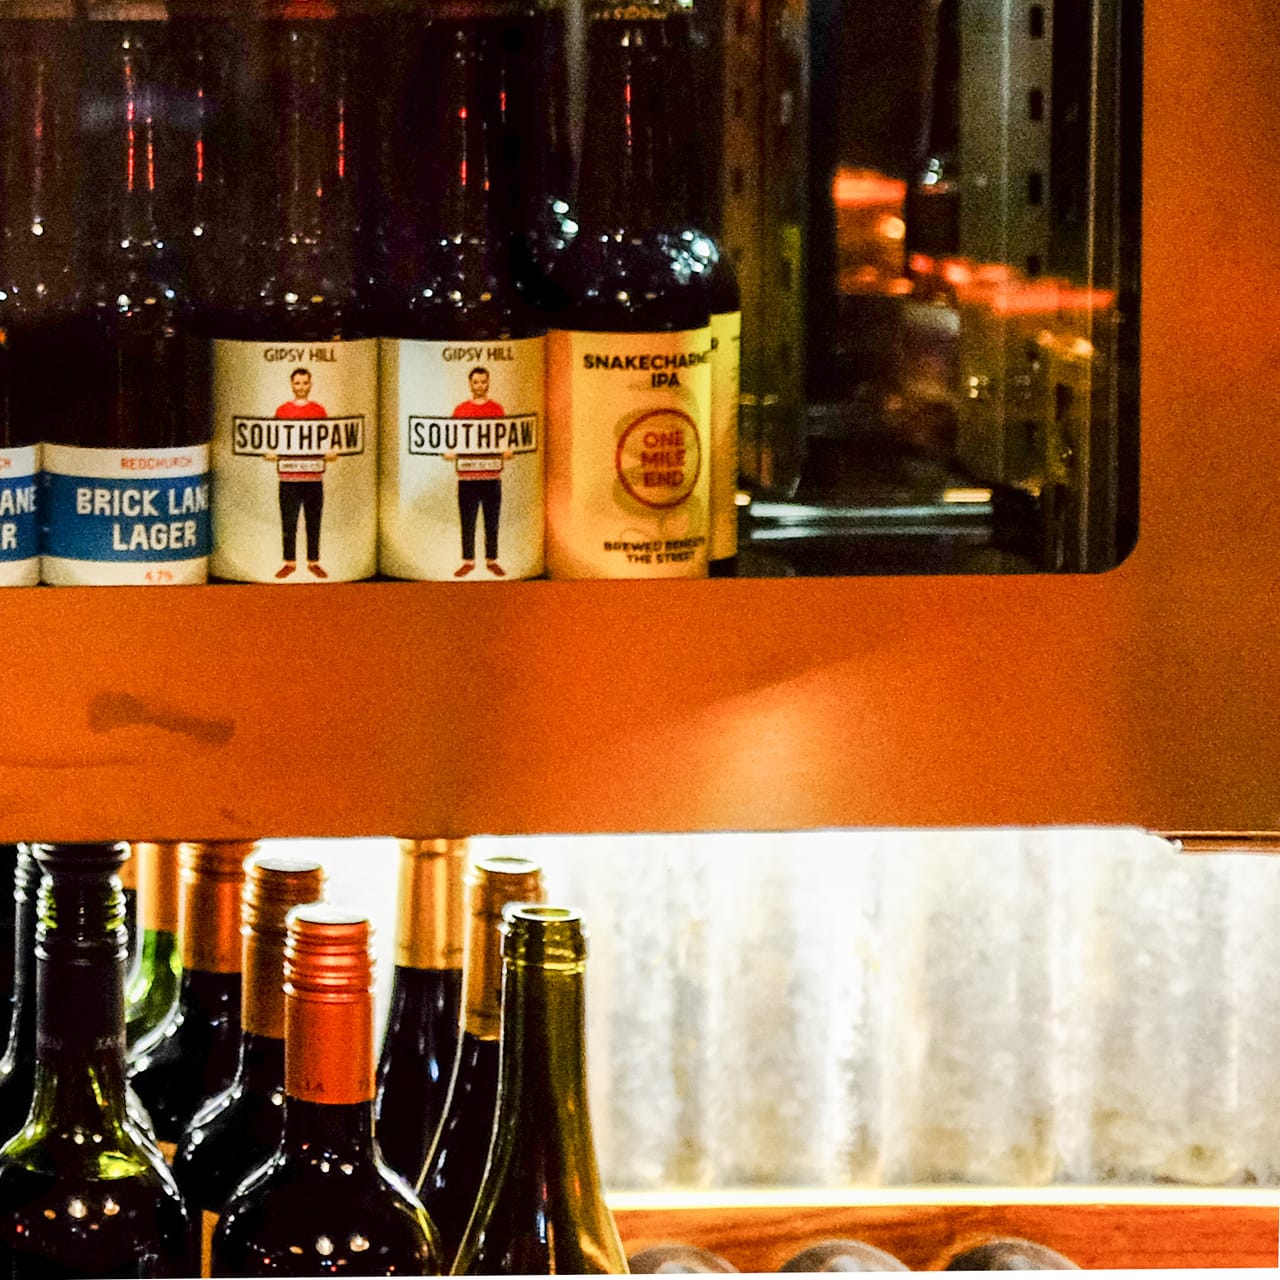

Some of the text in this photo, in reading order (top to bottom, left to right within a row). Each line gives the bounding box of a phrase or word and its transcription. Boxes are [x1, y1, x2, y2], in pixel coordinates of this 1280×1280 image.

[263, 348, 339, 363] GIPSY HILL
[442, 347, 515, 362] GIPSY HILL
[651, 372, 681, 389] IPA
[236, 422, 360, 451] SOUTHPAW
[413, 421, 534, 451] SOUTHPAW
[643, 429, 685, 449] ONE
[120, 456, 193, 471] REDCHURCH
[641, 449, 687, 469] MILE
[643, 470, 685, 488] END
[76, 487, 160, 517] BRICK
[112, 521, 198, 551] LAGER
[603, 540, 662, 553] BREWED
[626, 553, 652, 564] THE
